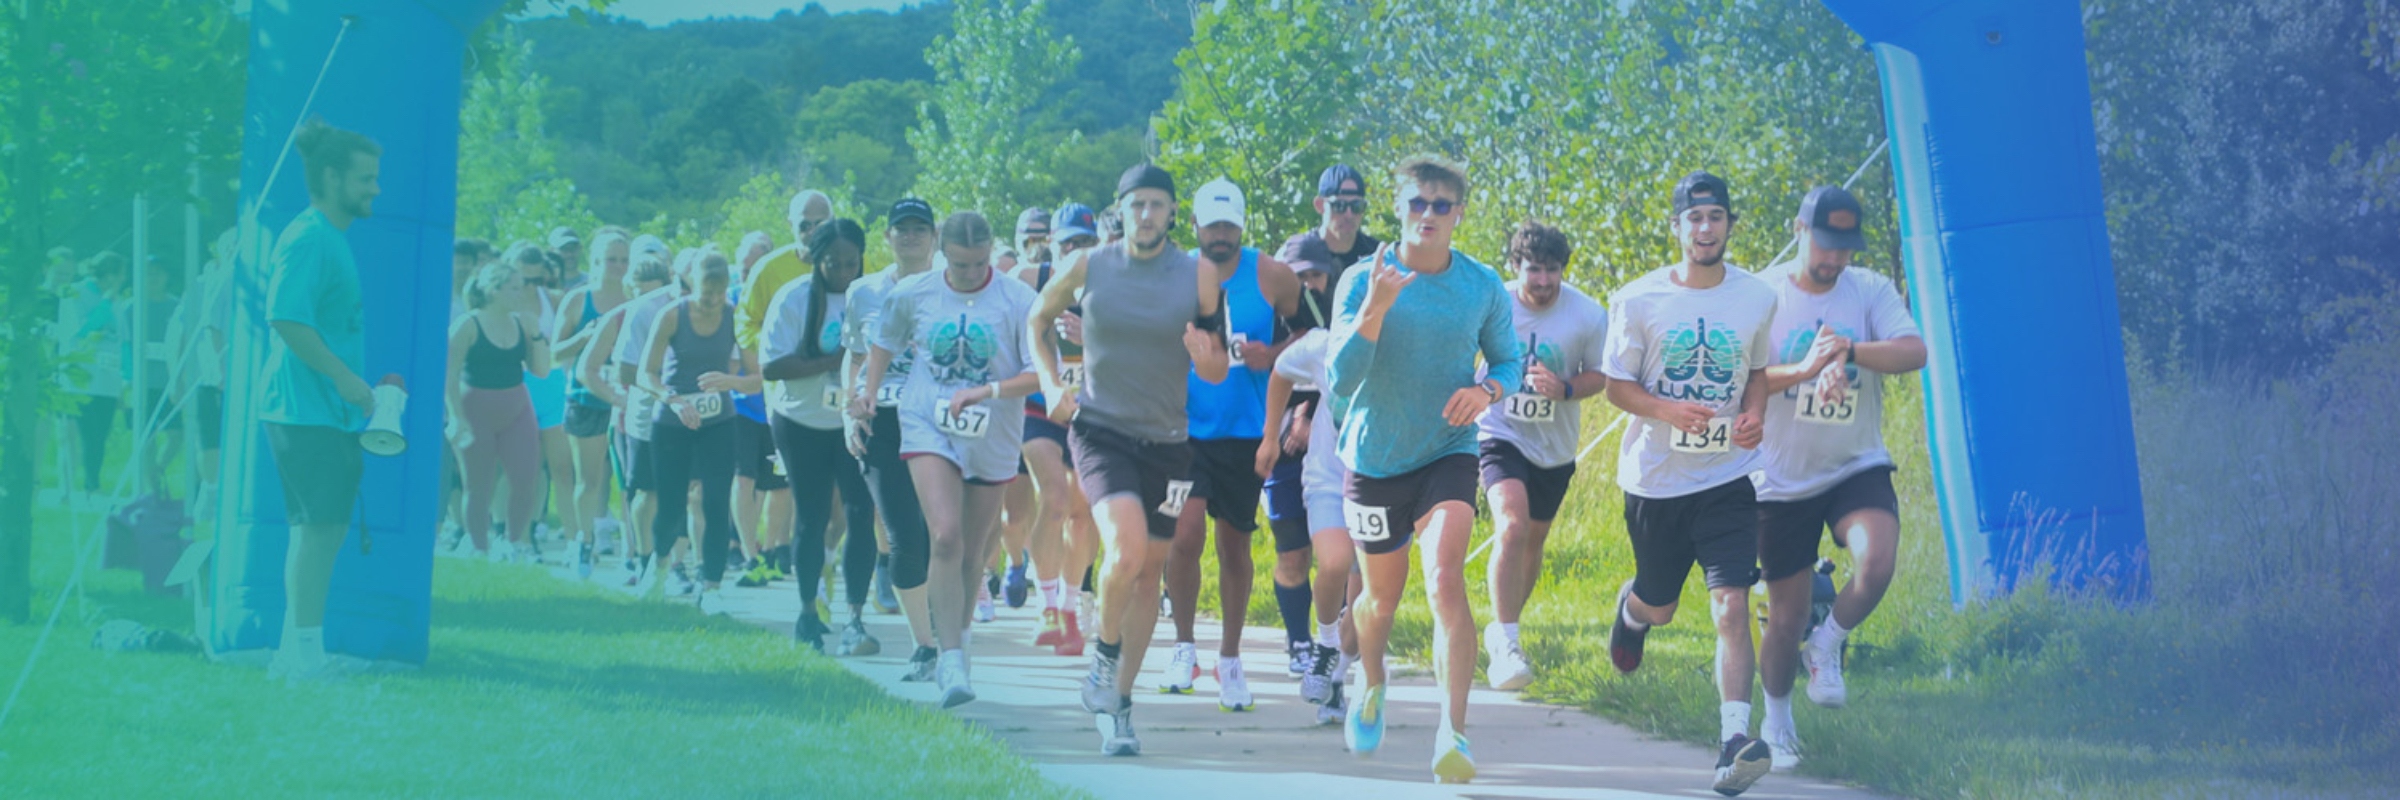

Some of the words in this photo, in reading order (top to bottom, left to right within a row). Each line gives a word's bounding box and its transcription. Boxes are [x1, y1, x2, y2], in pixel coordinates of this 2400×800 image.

[695, 395, 720, 415] 60
[1509, 396, 1552, 418] 103
[939, 406, 986, 433] 167
[1676, 424, 1728, 448] 134
[1357, 512, 1384, 537] 19
